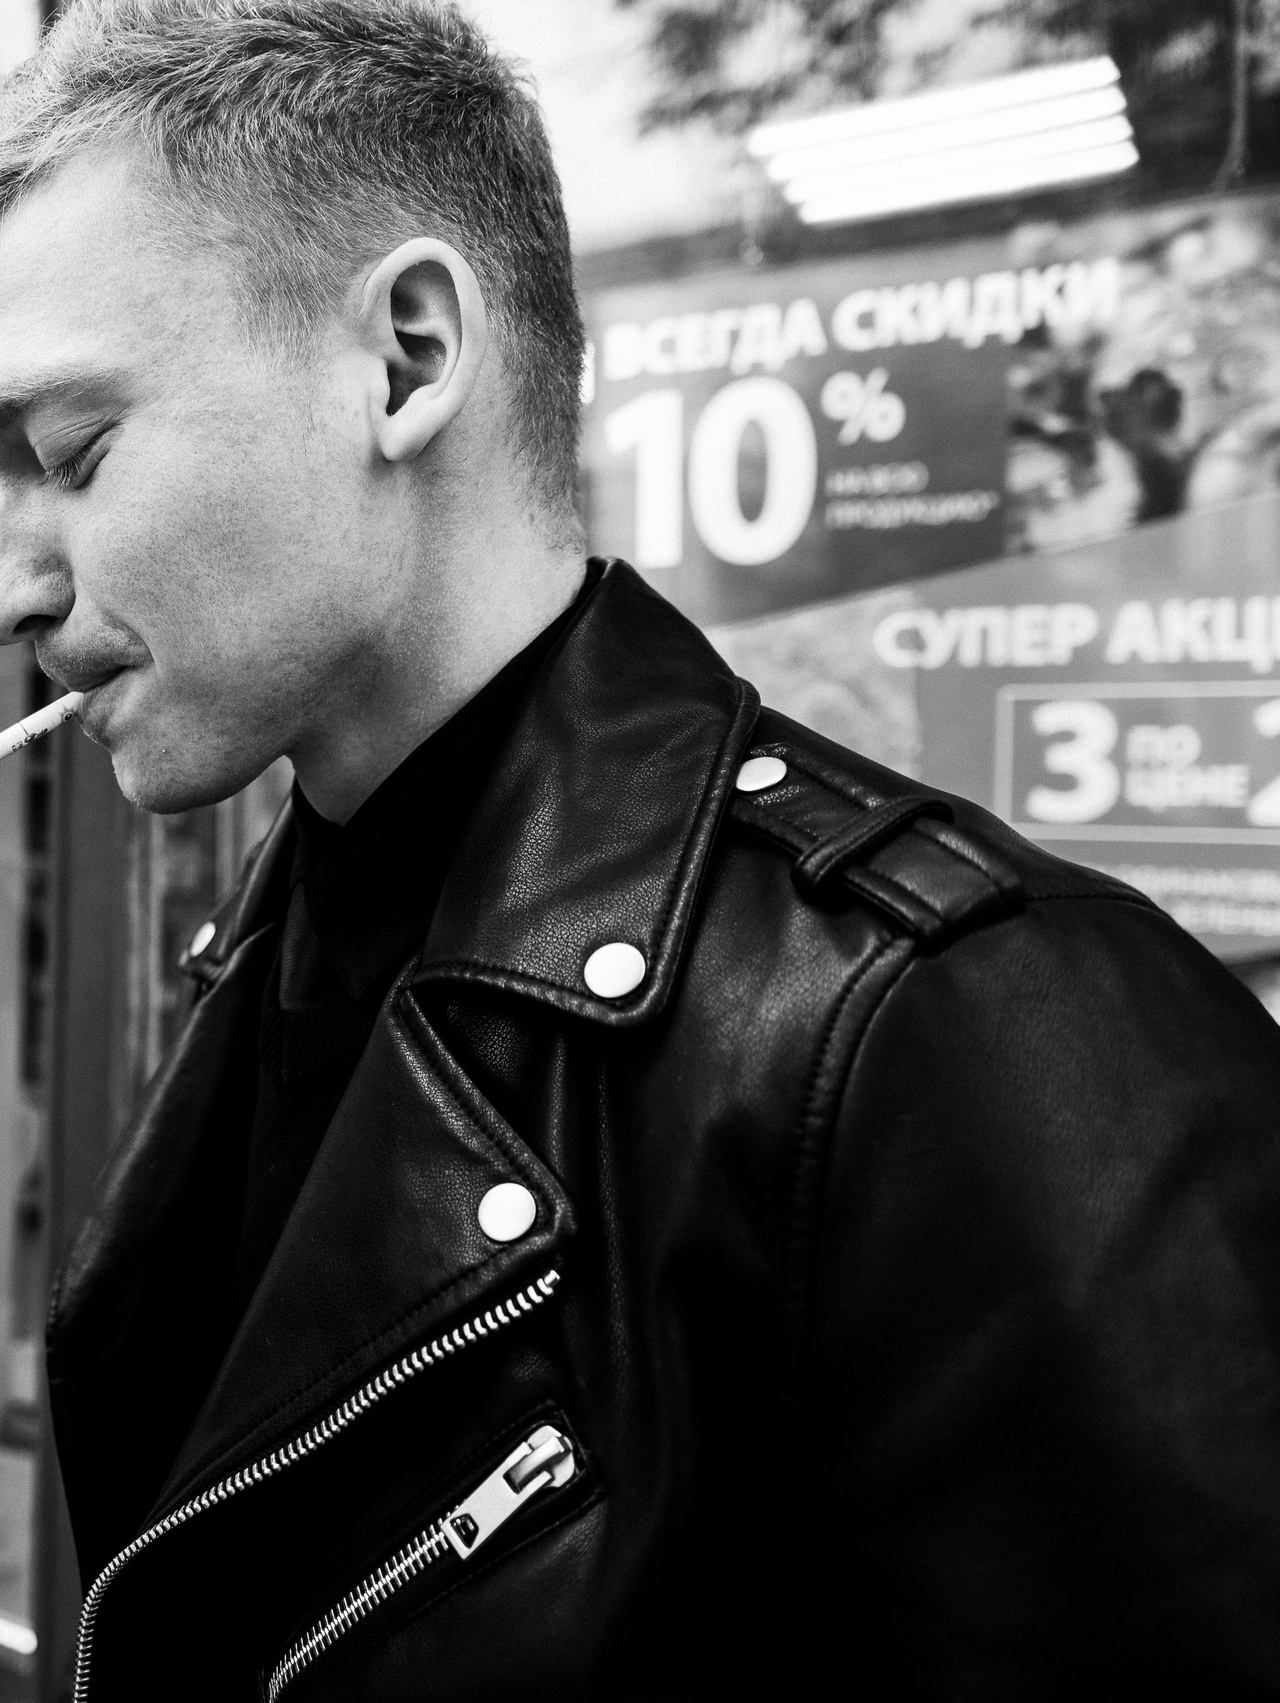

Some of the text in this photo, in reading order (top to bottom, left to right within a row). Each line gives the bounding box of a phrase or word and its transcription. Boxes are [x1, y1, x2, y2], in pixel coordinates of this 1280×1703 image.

[604, 259, 1122, 380] ВСЕГДА СКИДКИ
[604, 376, 818, 568] 10
[873, 596, 1280, 674] СУПЕР АКЦ
[1027, 700, 1119, 824] 3
[1125, 764, 1249, 813] ЦЕНЕ
[1126, 724, 1202, 768] ПО
